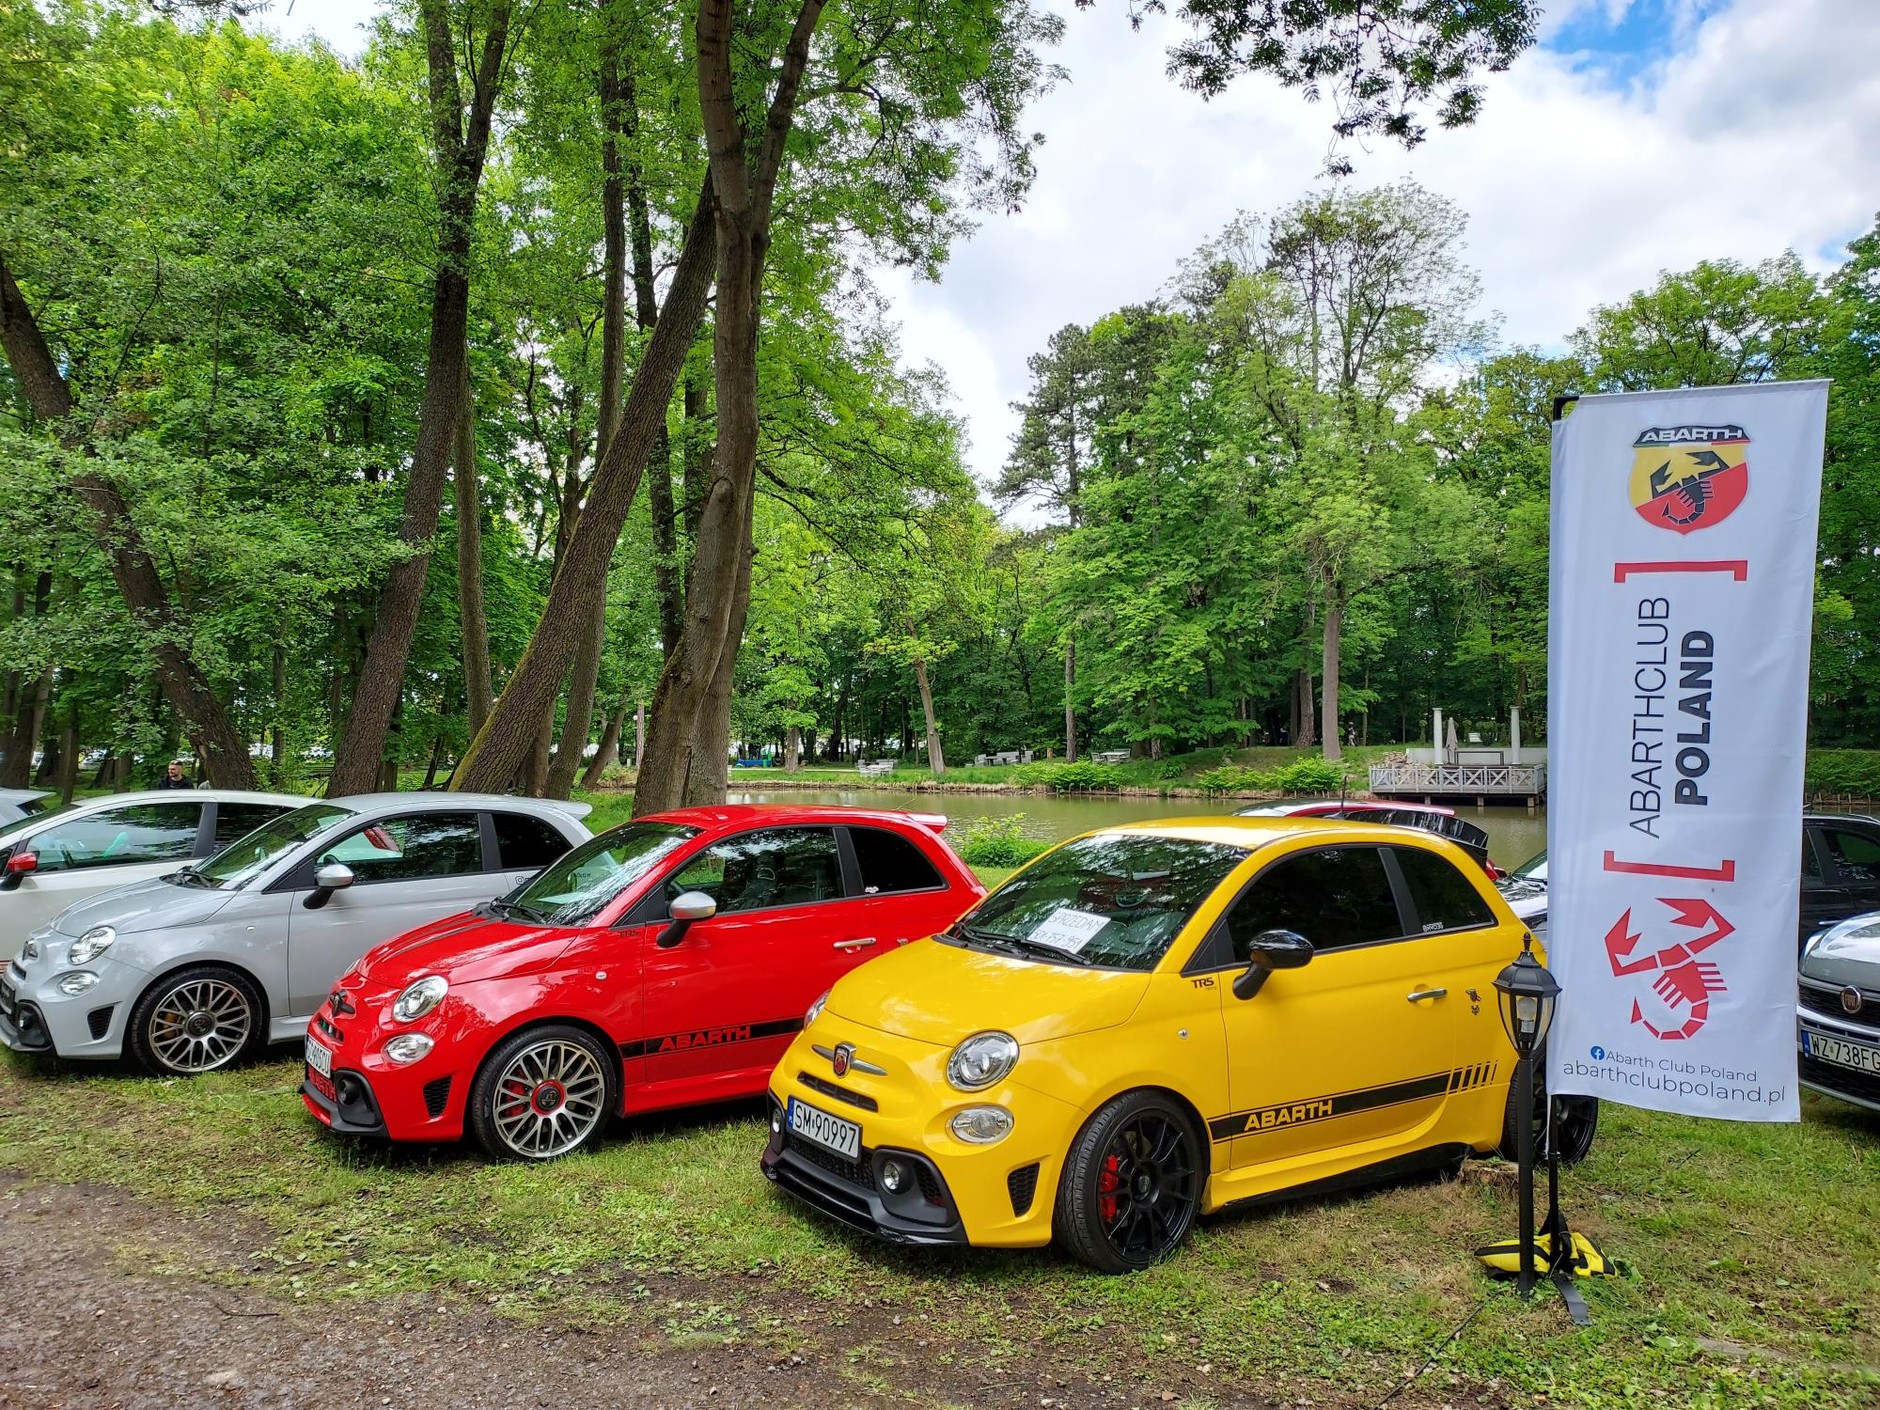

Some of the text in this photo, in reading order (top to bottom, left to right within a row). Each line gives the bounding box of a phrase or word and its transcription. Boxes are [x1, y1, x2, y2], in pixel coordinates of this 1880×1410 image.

[1641, 428, 1743, 442] ABARTH
[1629, 597, 1669, 839] ABARTHCLUB
[1674, 630, 1714, 806] POLAND
[659, 1026, 750, 1052] ABARTH
[1563, 1060, 1785, 1105] abarthclubpoland.pl
[1606, 1050, 1757, 1082] Abarth Club Poland
[1244, 1100, 1332, 1131] ABARTH
[815, 1114, 857, 1153] 90997
